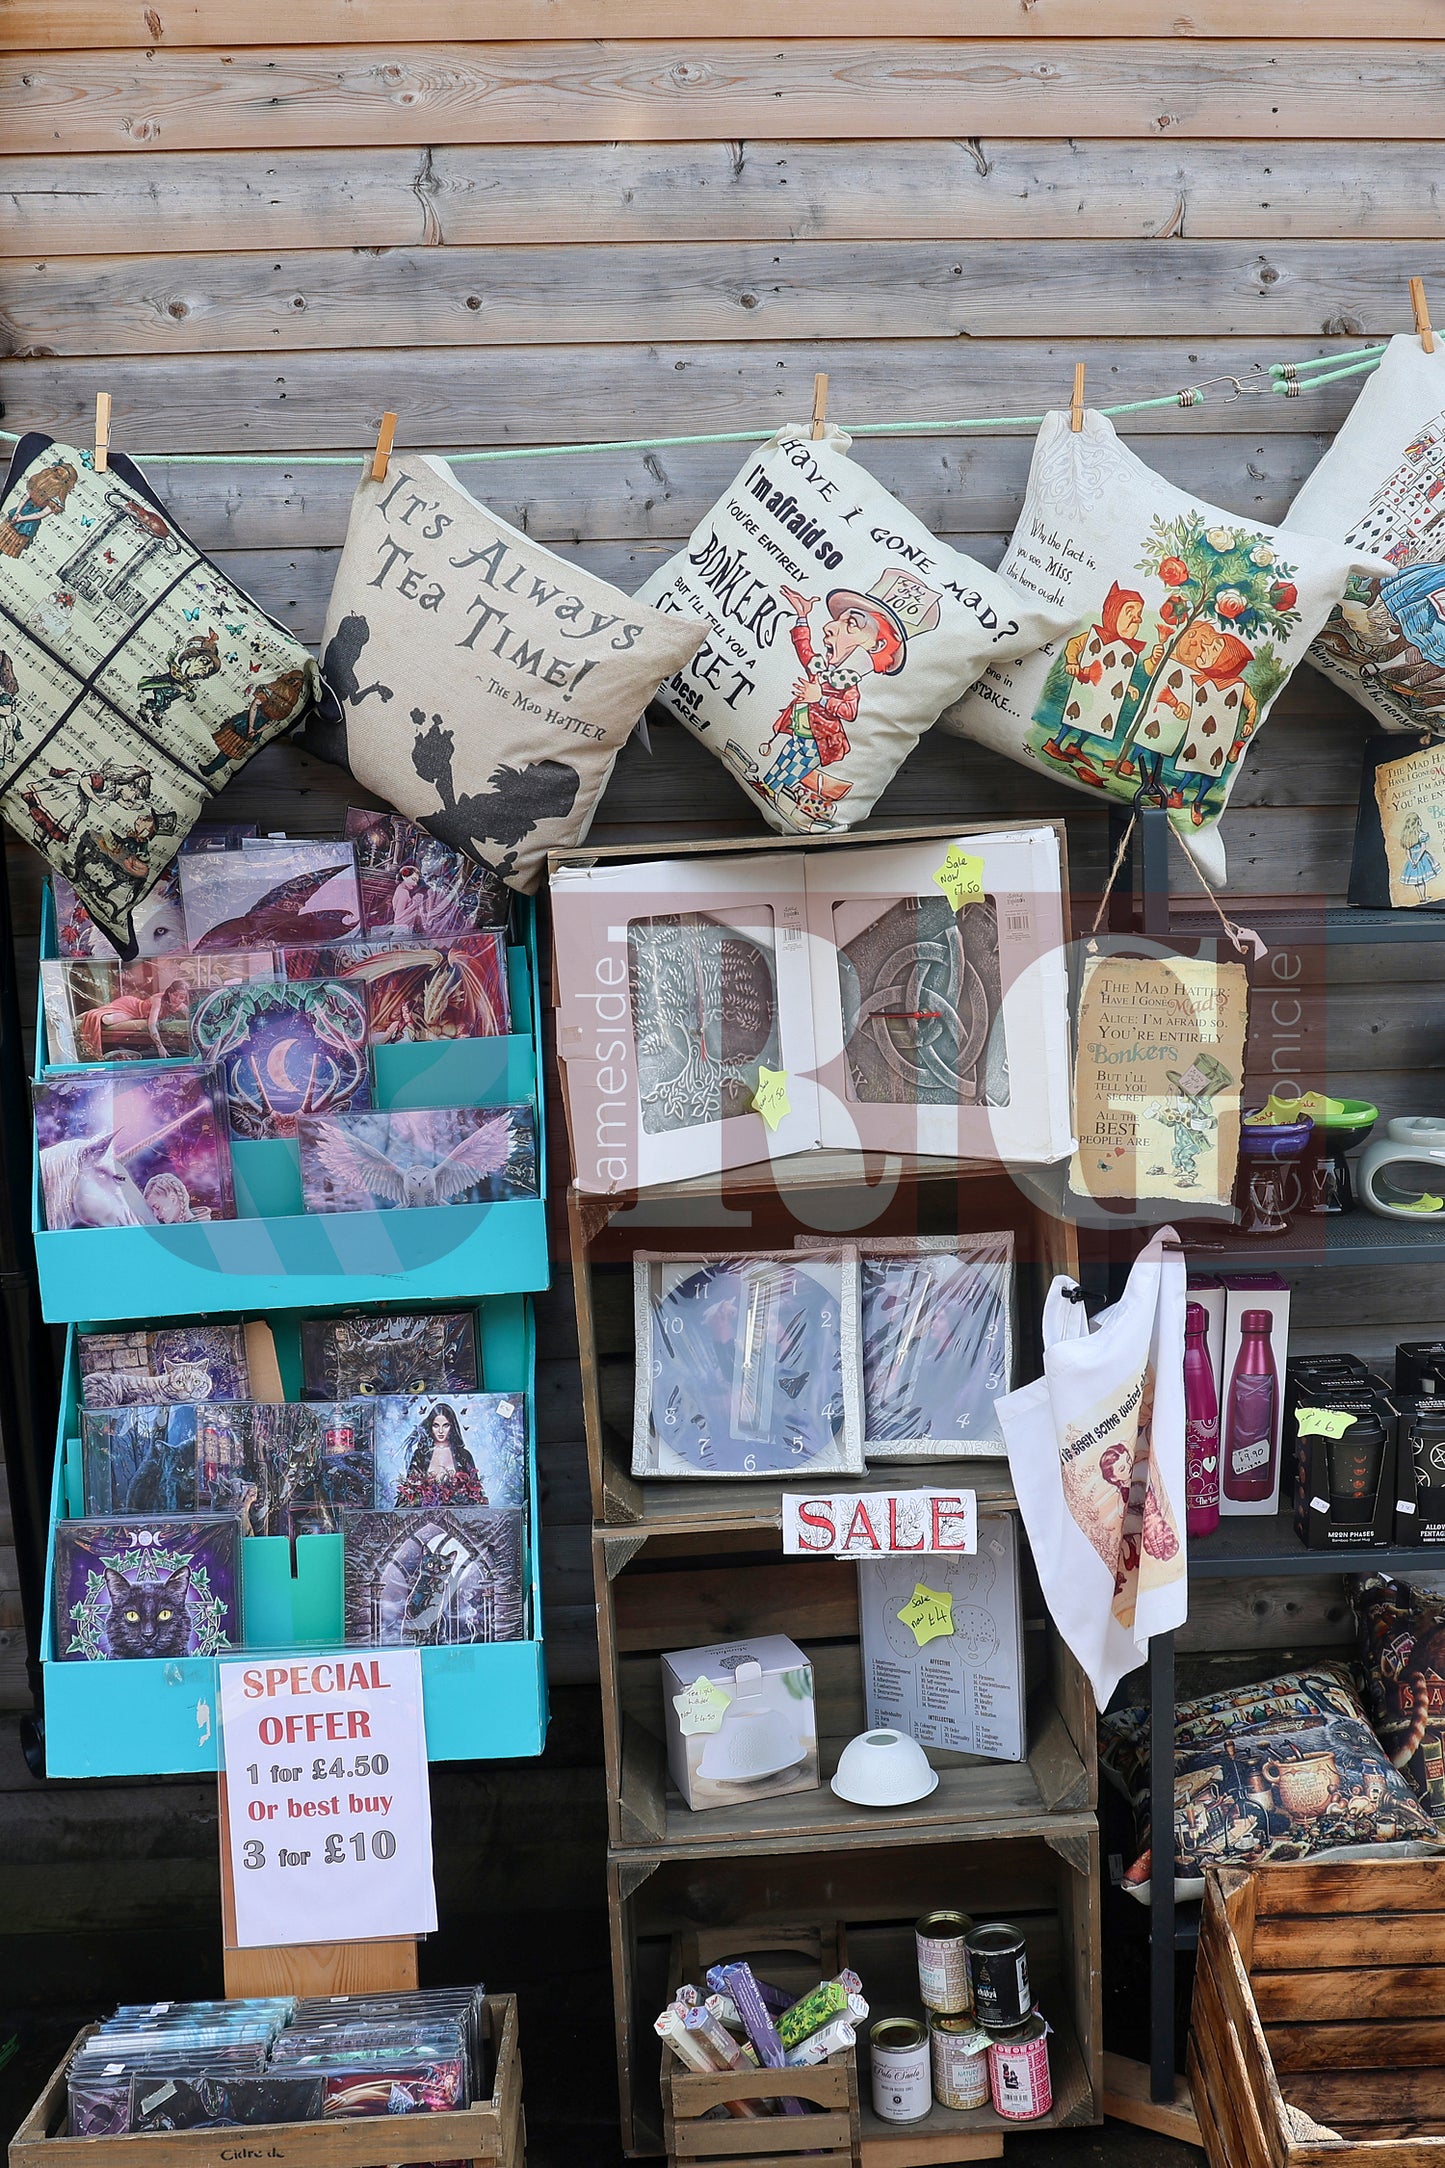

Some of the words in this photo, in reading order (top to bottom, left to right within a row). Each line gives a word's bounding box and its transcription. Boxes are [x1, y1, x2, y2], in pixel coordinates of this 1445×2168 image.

[744, 463, 773, 500] I'm
[766, 491, 826, 549] afraid
[815, 541, 844, 570] so
[726, 498, 760, 536] YOU'RE
[757, 534, 809, 583] ENTIRELY
[1030, 517, 1047, 545] Why
[1049, 531, 1061, 550] the
[1062, 539, 1084, 563] fact
[1086, 554, 1097, 570] is,
[870, 526, 937, 575] GONE
[1016, 547, 1029, 561] you
[1028, 553, 1042, 569] see,
[1045, 556, 1074, 585] Miss,
[689, 522, 798, 649] BONKERS
[1007, 564, 1019, 580] this
[1018, 567, 1037, 592] here
[1038, 587, 1065, 608] ought
[674, 577, 691, 596] BUT
[688, 594, 704, 614] I'LL
[704, 611, 726, 638] TELL
[726, 635, 747, 658] YOU
[746, 660, 756, 669] A
[1015, 658, 1023, 667] a
[1004, 675, 1013, 688] in
[671, 698, 711, 732] ARE!
[946, 856, 968, 869] Sale
[1101, 980, 1130, 994] THE
[1134, 981, 1169, 995] MAD
[1101, 995, 1129, 1006] HAVE
[1099, 1012, 1138, 1025] ALICE:
[1142, 1013, 1163, 1026] I'M
[1166, 1017, 1207, 1028] AFRAID
[1210, 1019, 1229, 1029] SO.
[1099, 1025, 1154, 1041] YOU'RE
[1159, 1032, 1224, 1044] ENTIRELY
[1087, 1042, 1179, 1065] Bonkers
[1097, 1070, 1122, 1083] BUT
[1094, 1082, 1121, 1092] TELL
[1125, 1083, 1147, 1093] YOU
[1094, 1092, 1103, 1101] A
[1106, 1092, 1147, 1102] SECRET
[1096, 1111, 1117, 1122] ALL
[1120, 1112, 1139, 1122] THE
[1095, 1123, 1140, 1136] BEST
[1079, 1135, 1122, 1146] PEOPLE
[1127, 1136, 1150, 1147] ARE
[663, 1317, 684, 1335] 10
[820, 1312, 832, 1328] 2
[956, 1412, 970, 1429] 4
[698, 1439, 709, 1457] 7
[792, 1436, 804, 1454] 5
[743, 1454, 756, 1472] 6
[797, 1496, 966, 1551] SALE
[242, 1660, 391, 1698] SPECIAL
[258, 1710, 371, 1745] OFFER
[247, 1763, 258, 1785] 1
[270, 1765, 302, 1783] for
[312, 1754, 389, 1780] £4.50
[248, 1800, 278, 1821] Or
[288, 1795, 339, 1818] best
[349, 1793, 393, 1816] buy
[242, 1839, 266, 1870] 3
[278, 1848, 310, 1867] for
[324, 1830, 397, 1865] £10
[221, 2148, 262, 2161] Cidre
